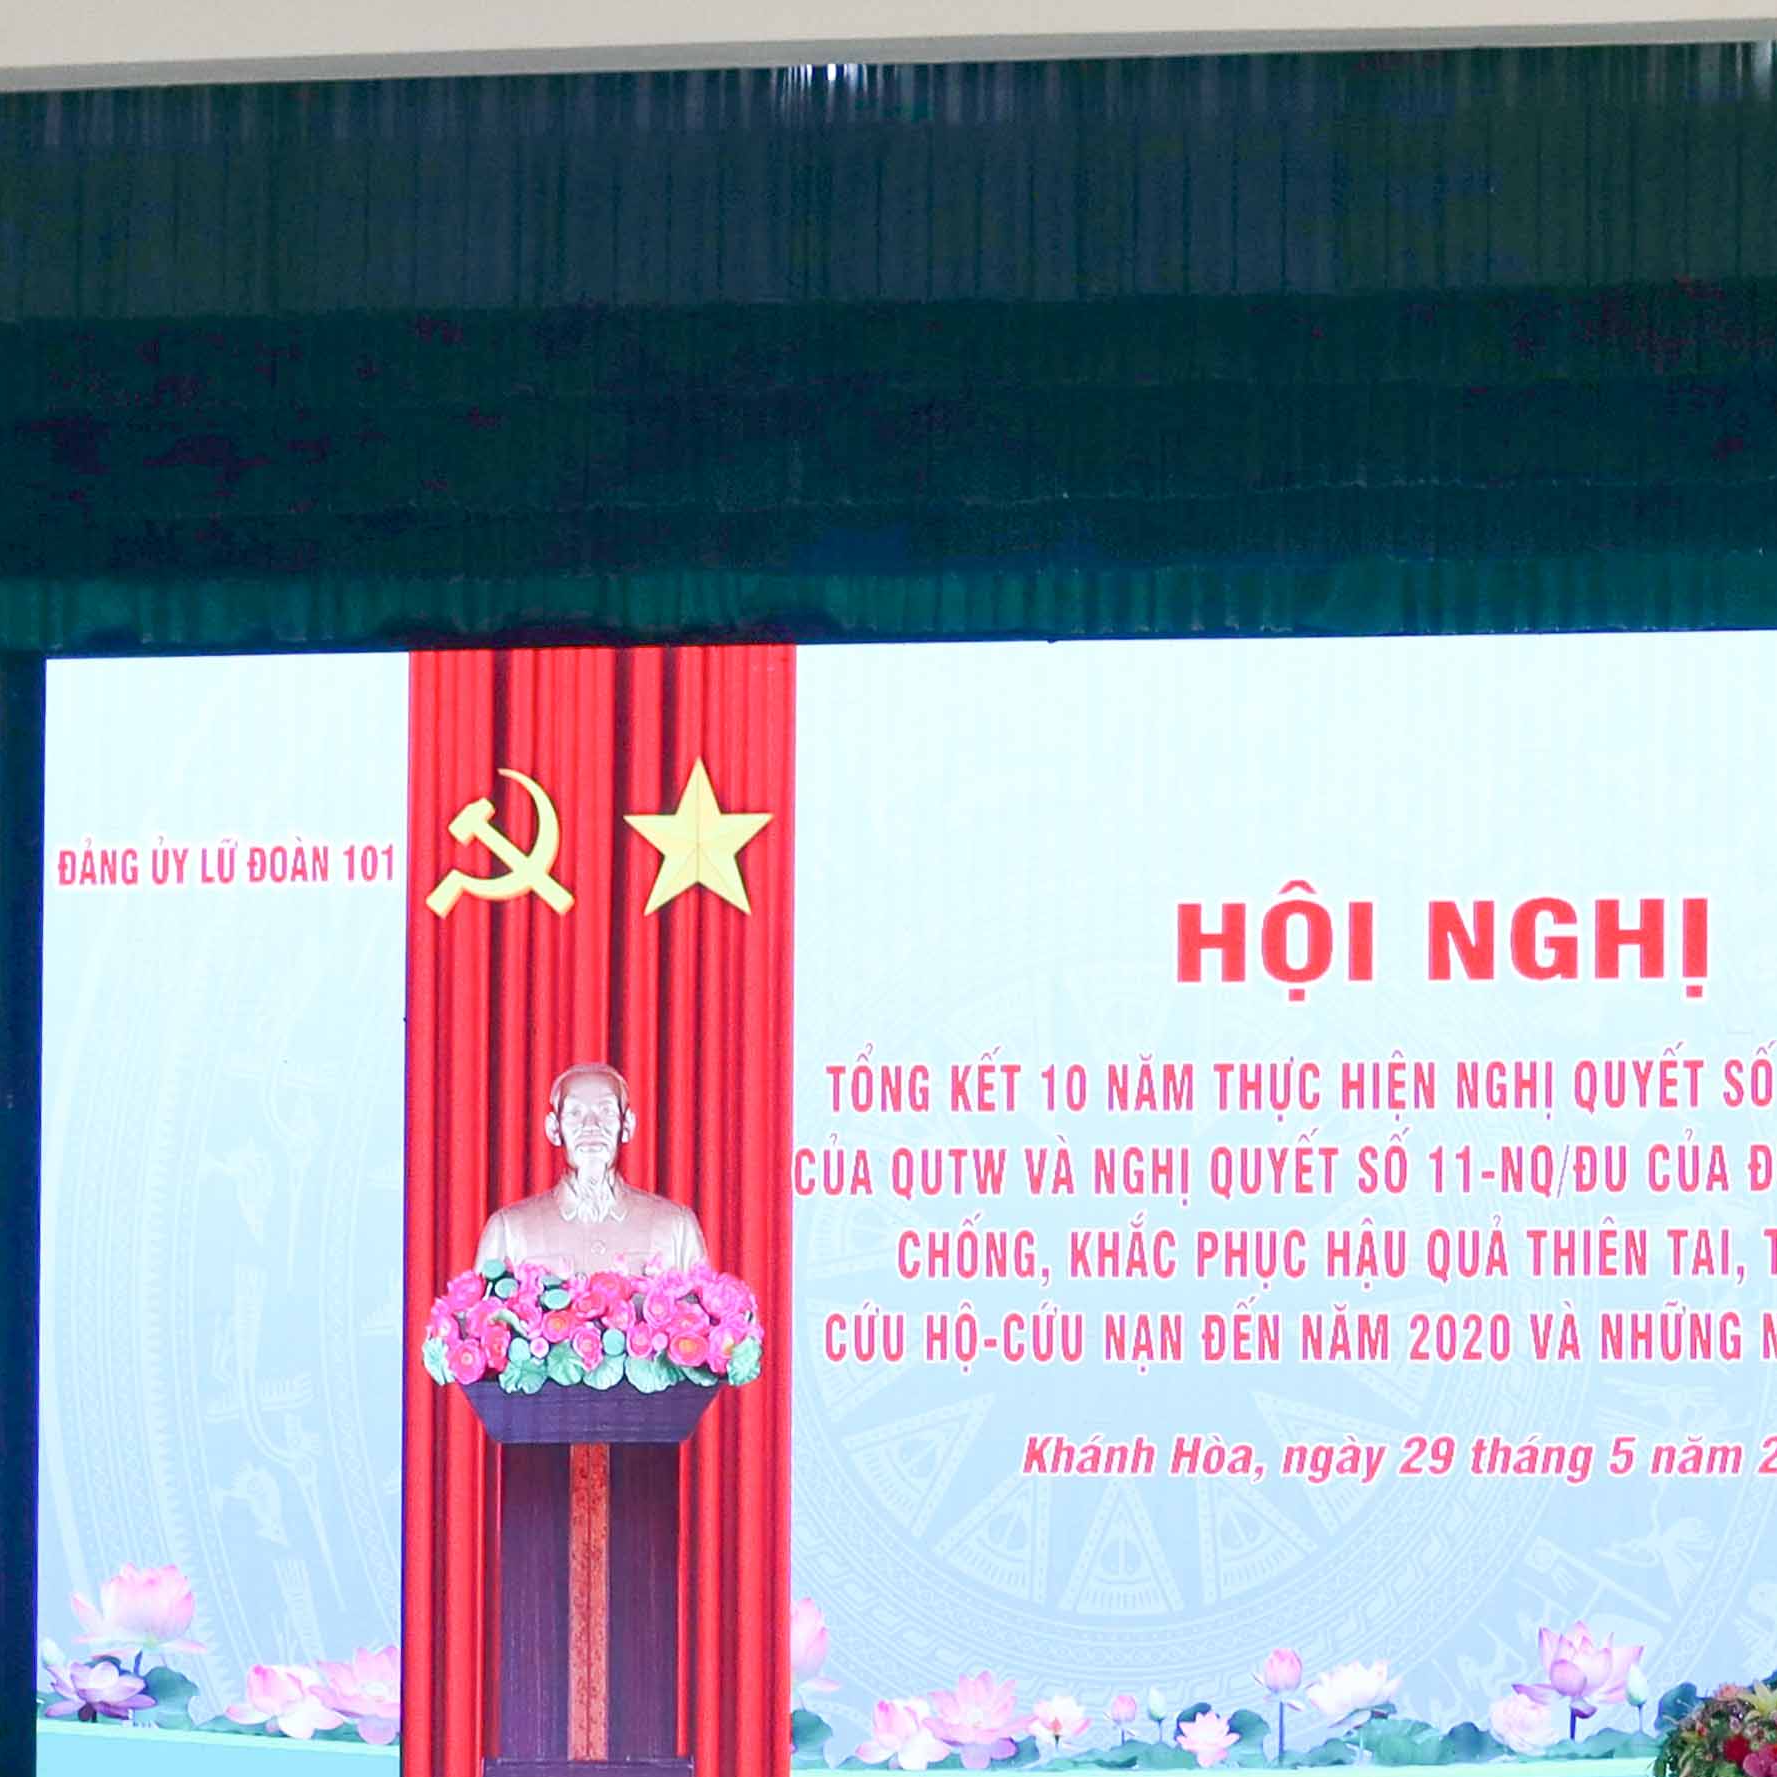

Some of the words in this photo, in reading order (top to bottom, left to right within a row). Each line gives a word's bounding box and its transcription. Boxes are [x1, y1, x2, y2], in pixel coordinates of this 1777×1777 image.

[57, 834, 139, 886] ĐẢNG
[151, 836, 189, 885] ỦY
[247, 836, 330, 883] ĐOÀN
[343, 845, 394, 881] 101
[1177, 879, 1374, 1001] HỘI
[1427, 897, 1709, 998] NGHỊ
[826, 1042, 929, 1112] TỔNG
[951, 1046, 1021, 1111] KẾT
[1041, 1064, 1087, 1111] 10
[1108, 1054, 1194, 1110] NĂM
[1214, 1057, 1321, 1121] THỰC
[1342, 1050, 1435, 1120] HIỆN
[1457, 1061, 1553, 1120] NGHỊ
[1573, 1041, 1704, 1113] QUYẾT
[1723, 1040, 1777, 1107] SỐ
[794, 1133, 872, 1196] CỦA
[892, 1148, 1006, 1200] QUTW
[1025, 1134, 1074, 1195] VÀ
[1095, 1147, 1190, 1207] NGHỊ
[1210, 1127, 1338, 1198] QUYẾT
[1359, 1128, 1408, 1193] SỐ
[1430, 1144, 1627, 1198] 11-NQ/ĐU
[1648, 1128, 1728, 1192] CỦA
[898, 1212, 1051, 1286] CHỐNG,
[1070, 1211, 1176, 1278] KHẮC
[1197, 1230, 1305, 1289] PHỤC
[1327, 1218, 1406, 1289] HẬU
[1428, 1215, 1508, 1281] QUẢ
[1527, 1215, 1646, 1276] THIÊN
[1667, 1227, 1745, 1283] TAI,
[826, 1301, 905, 1362] CỨU
[927, 1302, 1083, 1372] HỘ-CỨU
[1105, 1314, 1182, 1372] NẠN
[1202, 1296, 1280, 1361] ĐẾN
[1303, 1304, 1388, 1361] NĂM
[1410, 1313, 1511, 1361] 2020
[1531, 1301, 1581, 1360] VÀ
[1601, 1301, 1741, 1361] NHỮNG
[1023, 1435, 1155, 1473] Khánh
[1171, 1435, 1264, 1481] Hòa,
[1281, 1435, 1385, 1483] ngày
[1400, 1436, 1455, 1474] 29
[1471, 1436, 1592, 1483] tháng
[1610, 1436, 1635, 1474] 5
[1652, 1437, 1742, 1474] năm
